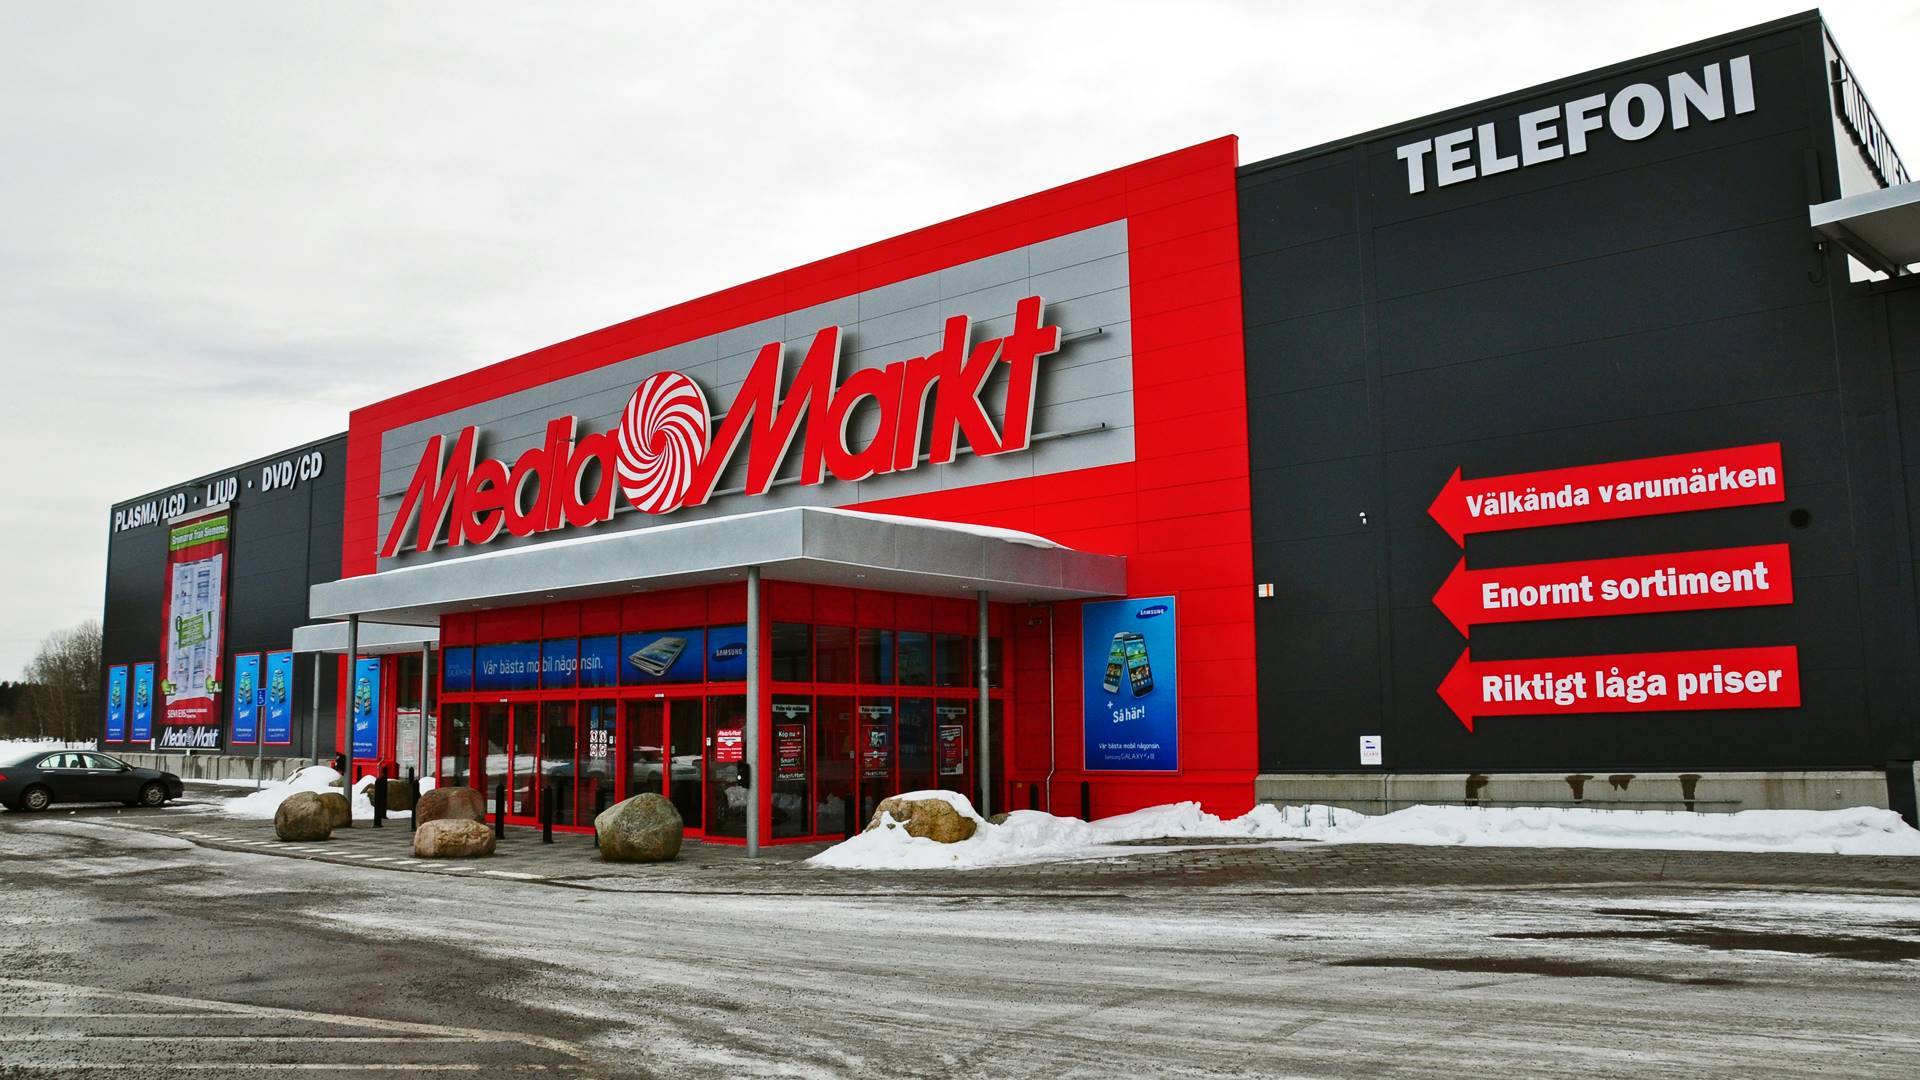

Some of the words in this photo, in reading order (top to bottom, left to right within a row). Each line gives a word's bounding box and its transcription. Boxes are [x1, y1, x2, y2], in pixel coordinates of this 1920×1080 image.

[1396, 54, 1756, 194] TELEFONI
[380, 414, 618, 558] Media
[682, 295, 1062, 507] Markt
[115, 493, 186, 532] PLASMA/LCD
[206, 477, 237, 507] LJUD
[262, 452, 323, 490] DVD/CD
[1465, 484, 1590, 518] Välkända
[1598, 465, 1777, 503] varumärken
[1481, 575, 1594, 610] Enormt
[1600, 561, 1770, 600] sortiment
[1140, 608, 1165, 616] SAMSUNG
[482, 660, 498, 676] Vår
[499, 658, 525, 675] bästa
[526, 655, 553, 673] mobil
[554, 653, 604, 676] någonsin.
[716, 647, 743, 657] SAMSUNG
[1481, 671, 1588, 706] Riktigt
[1594, 666, 1668, 703] låga
[1677, 664, 1784, 701] priser
[1113, 709, 1125, 724] Så
[1125, 705, 1145, 721] här!
